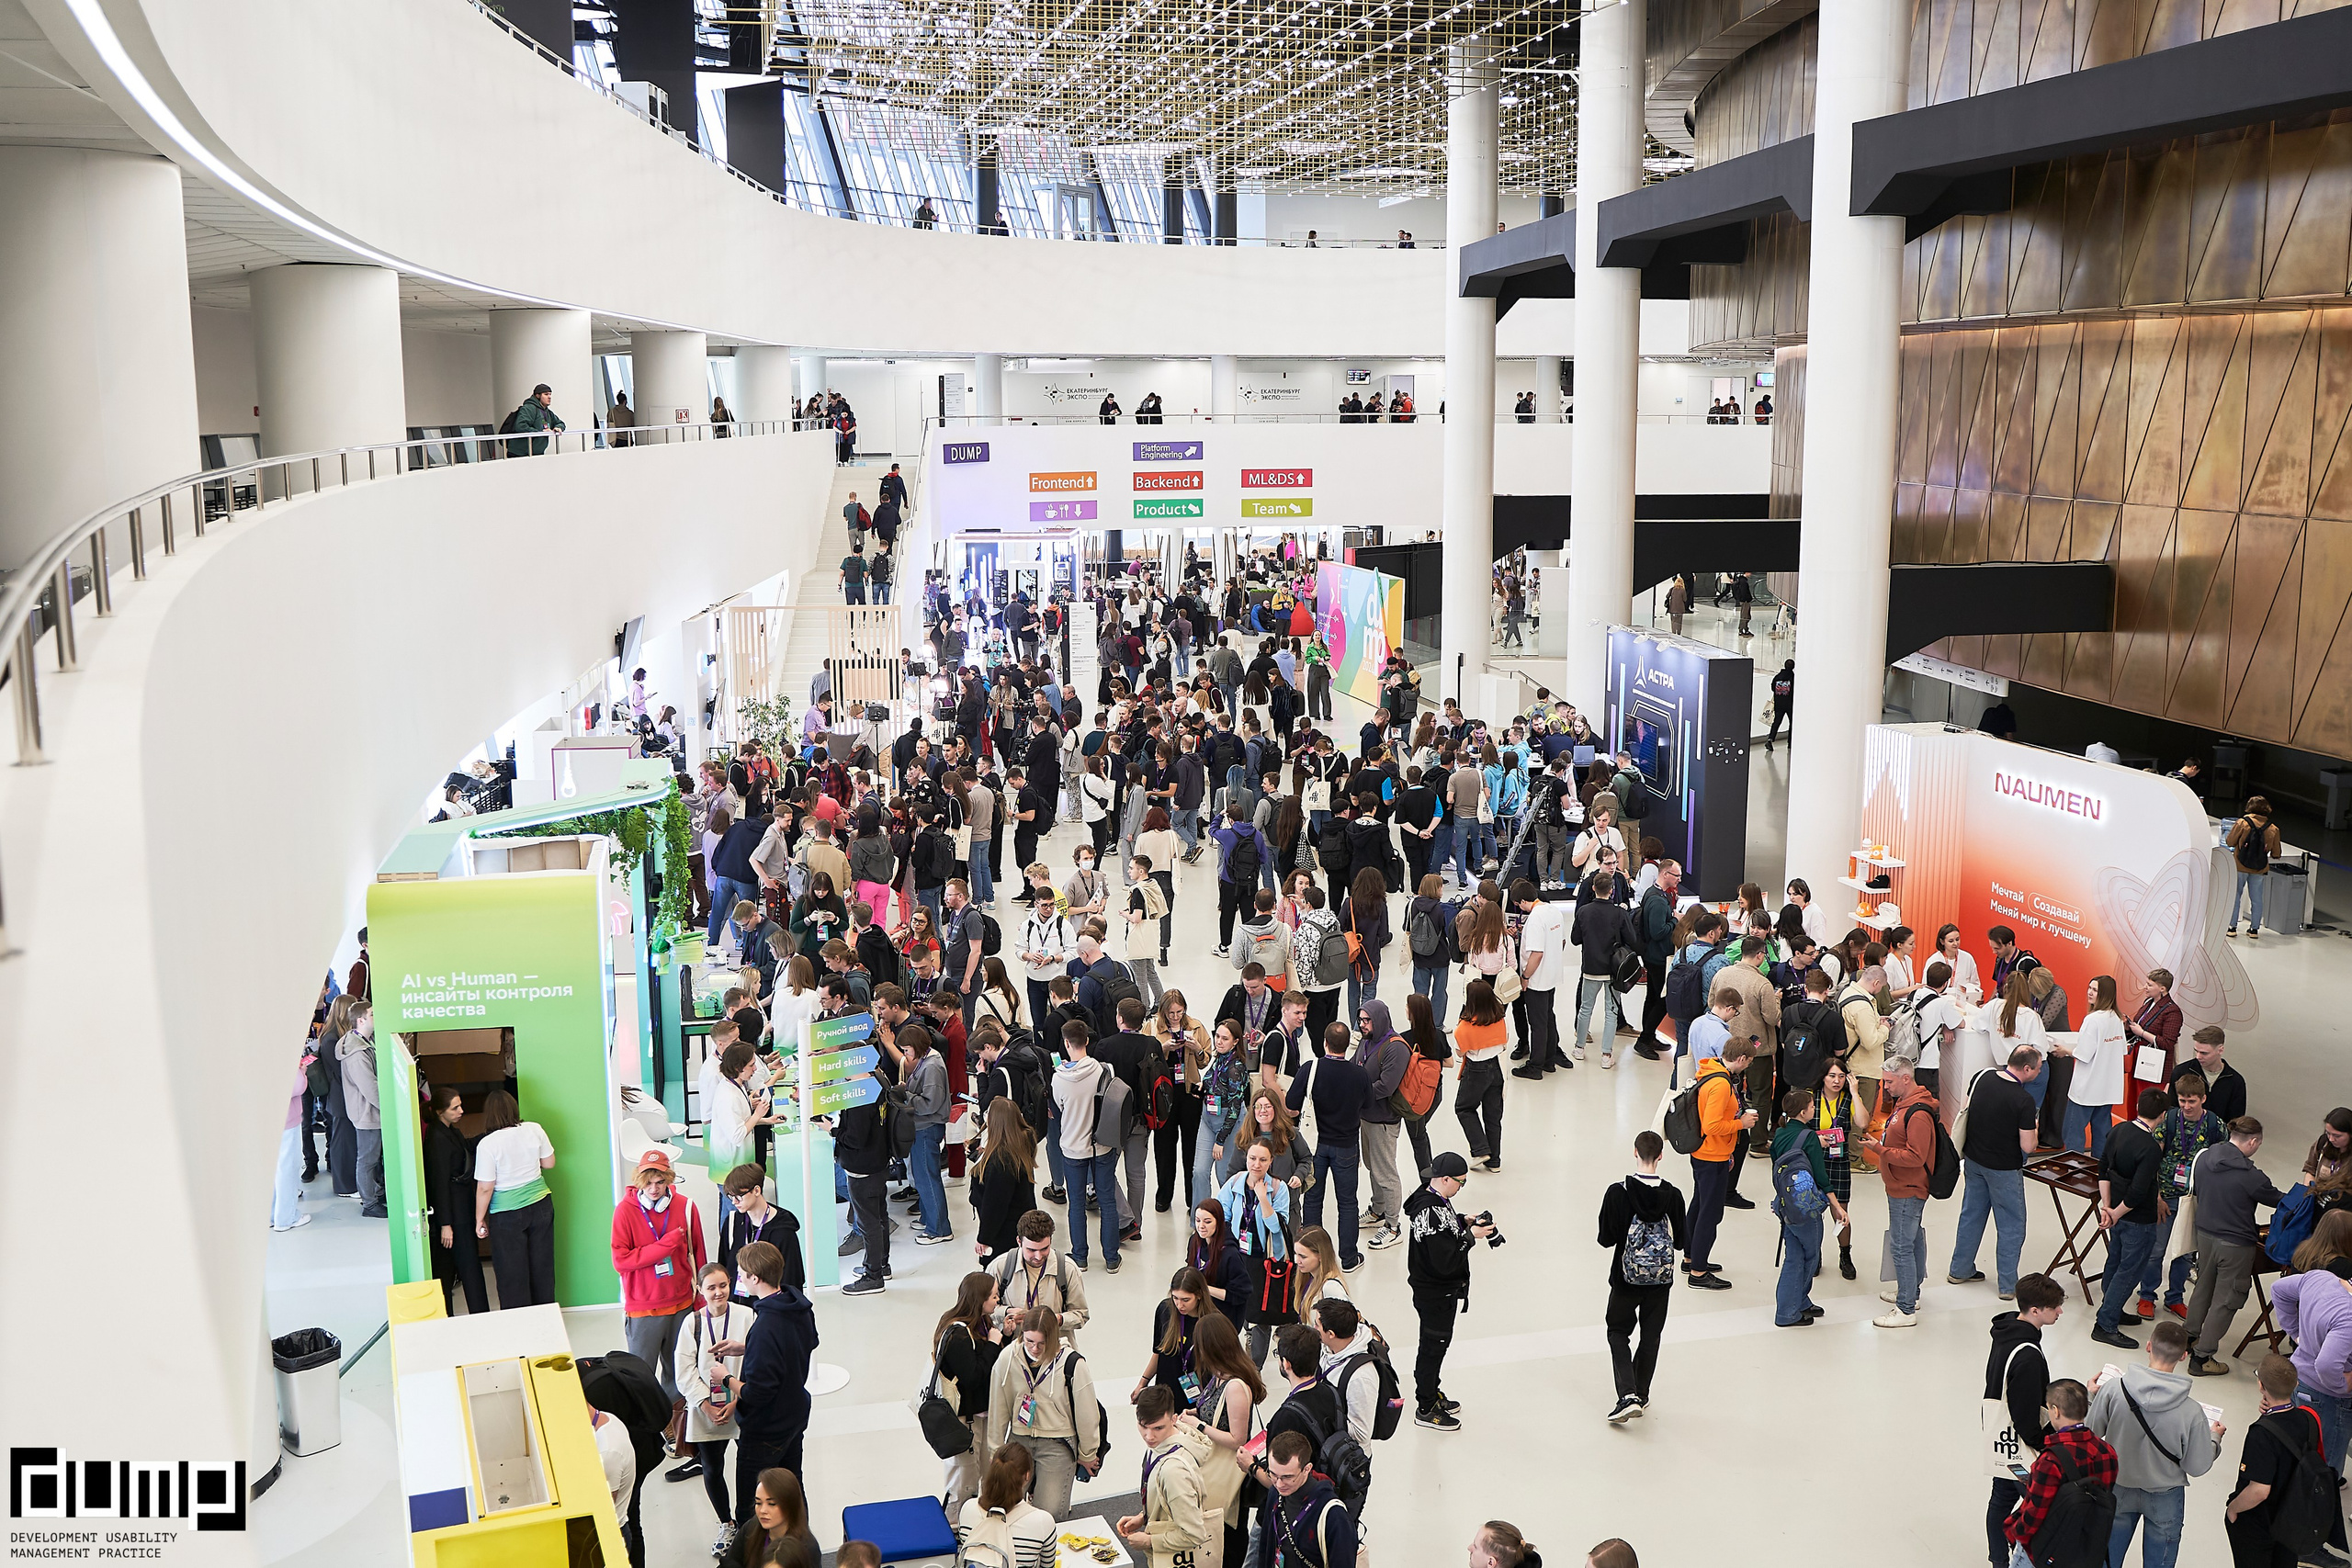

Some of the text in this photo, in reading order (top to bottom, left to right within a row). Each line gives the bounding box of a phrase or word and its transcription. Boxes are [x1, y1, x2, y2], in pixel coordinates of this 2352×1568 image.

[951, 446, 982, 461] DUMP
[1140, 451, 1182, 460] Engineering
[1032, 476, 1084, 490] Frontend
[1136, 475, 1191, 489] Backend
[1249, 473, 1295, 485] ML&DS
[1136, 503, 1187, 516] Product
[1252, 502, 1287, 514] Team
[1648, 669, 1675, 690] АСТРА
[1995, 773, 2100, 820] NAUMEN
[1991, 882, 2080, 923] Мечтай Создавай
[1990, 898, 2092, 949] Меняй мир к лучшему
[401, 974, 421, 988] AI
[426, 976, 447, 987] vs
[451, 972, 517, 987] Human
[401, 986, 573, 1004] инсайты контроля
[402, 1004, 486, 1019] качества
[817, 1022, 868, 1040] Ручной ввод
[819, 1055, 866, 1073] Hard skills
[820, 1088, 866, 1105] Soft skills
[1994, 1440, 2018, 1460] mp
